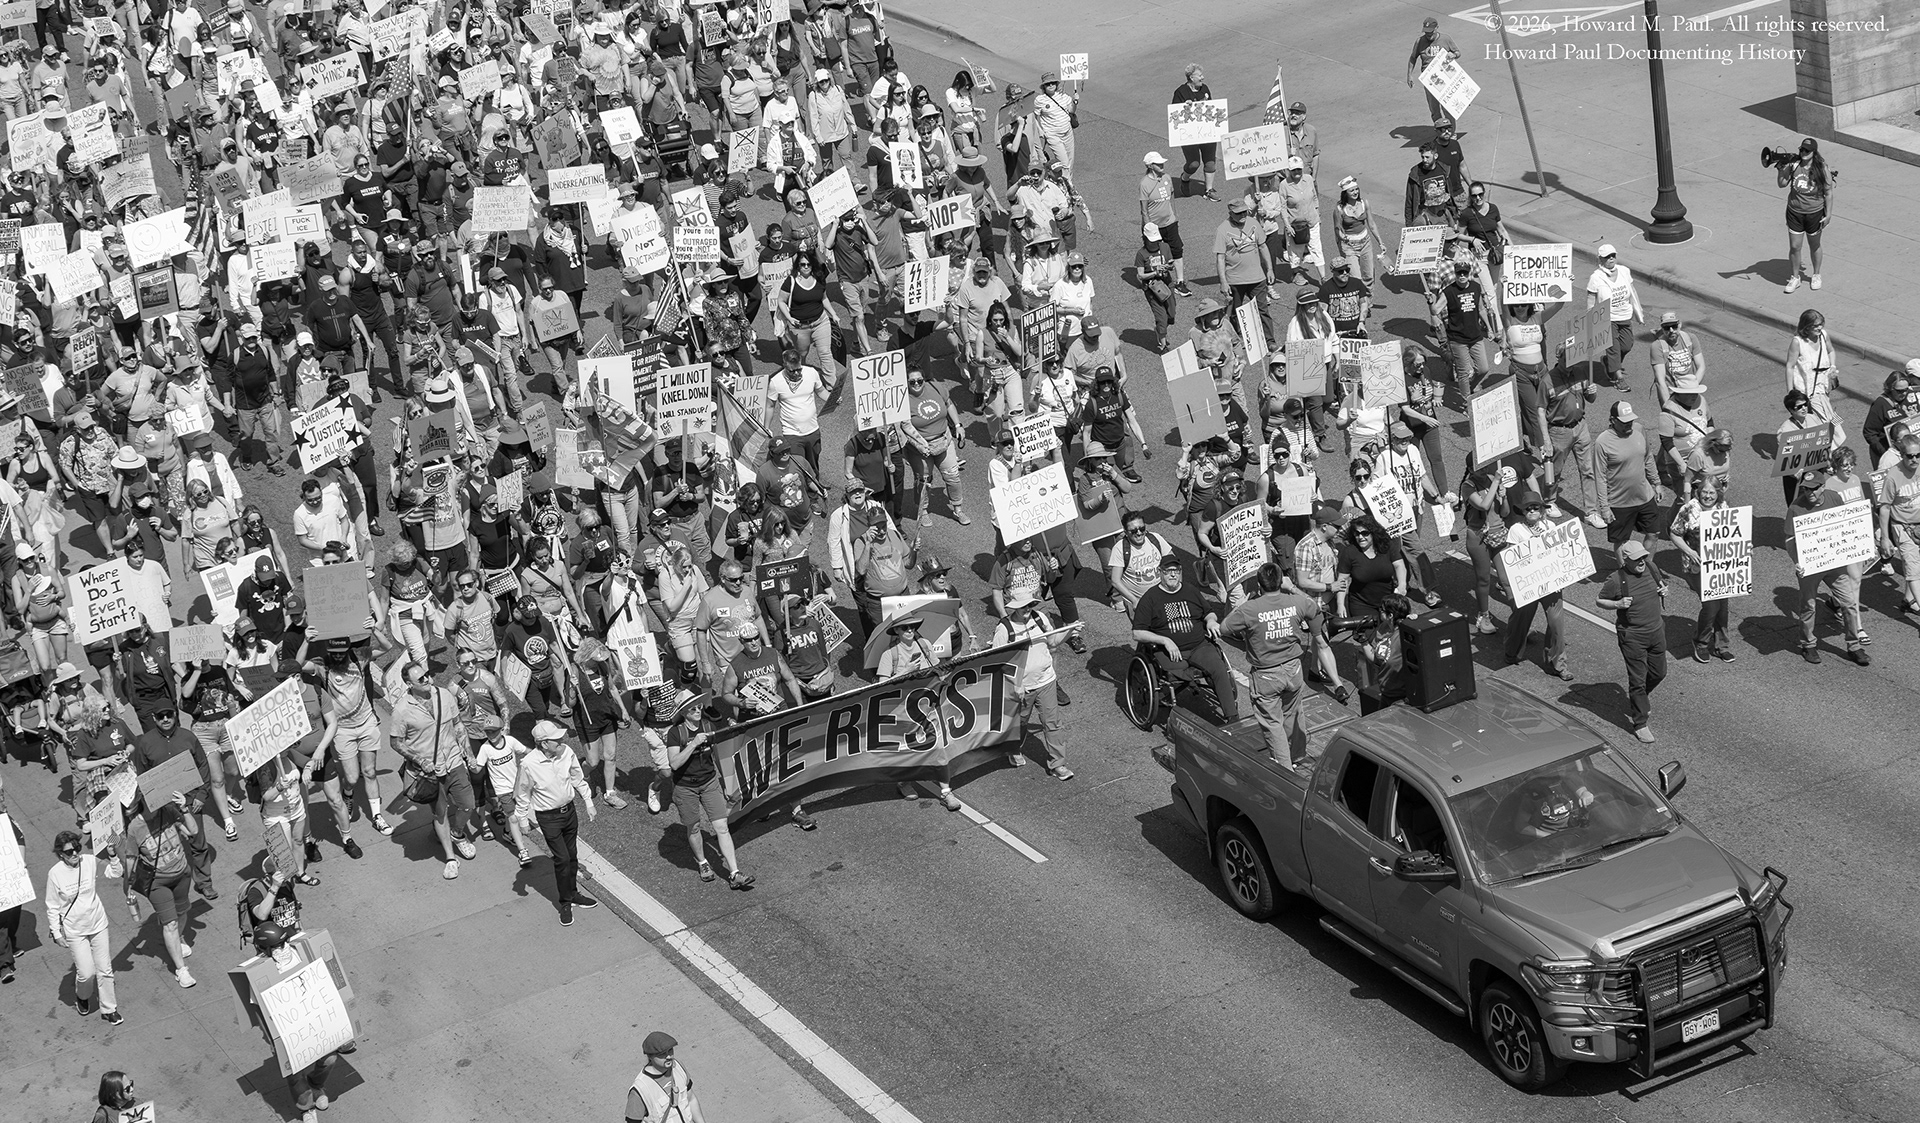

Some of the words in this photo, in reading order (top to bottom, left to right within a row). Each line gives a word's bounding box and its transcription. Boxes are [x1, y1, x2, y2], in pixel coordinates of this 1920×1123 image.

[1062, 54, 1075, 64] NO
[311, 63, 325, 75] NO
[322, 66, 345, 84] KINGS
[1061, 61, 1089, 76] KINGS
[1442, 76, 1467, 105] FASCISTS
[1239, 147, 1252, 156] for
[1258, 146, 1269, 155] my
[574, 169, 589, 177] ARE
[1229, 156, 1282, 173] Grandchildren
[216, 172, 230, 182] NO
[549, 174, 604, 191] UNDERREACTING
[572, 188, 590, 198] FEAR
[685, 212, 708, 228] NO
[621, 219, 657, 242] DIVERSITY
[634, 238, 655, 252] NOT
[682, 238, 718, 246] OUTRAGED
[1513, 255, 1569, 271] PEDOPHILE
[1513, 270, 1534, 280] PRIDE
[1535, 270, 1551, 278] FLAG
[1507, 282, 1529, 298] RED
[1529, 281, 1549, 297] HAT
[1023, 313, 1034, 327] NO
[1035, 305, 1054, 323] KING
[462, 324, 486, 333] resist.
[543, 329, 551, 337] NO
[554, 324, 569, 334] KINGS
[1030, 325, 1039, 337] NO
[1040, 318, 1055, 332] WAR
[73, 332, 94, 352] REICH
[1043, 330, 1055, 346] NO
[1043, 343, 1055, 356] ICE
[855, 352, 904, 381] STOP
[660, 375, 667, 389] I
[669, 371, 685, 388] WILL
[685, 368, 708, 386] NOT
[736, 376, 764, 392] LOVE
[870, 377, 892, 388] the
[661, 391, 687, 406] KNEEL
[687, 386, 709, 401] DOWN
[857, 385, 909, 416] ATROCITY
[663, 410, 675, 418] WILL
[1105, 411, 1116, 420] NO
[1476, 408, 1513, 433] CABINETS
[308, 417, 346, 450] JUSTICE
[660, 420, 671, 431] ICE
[662, 427, 673, 436] OUT
[1013, 419, 1051, 437] Democracy
[1018, 432, 1037, 446] Needs
[1036, 428, 1053, 440] Your
[1019, 438, 1053, 455] Courage
[309, 452, 322, 465] for
[1780, 453, 1801, 472] NO
[1002, 468, 1057, 497] MORONS
[1008, 495, 1031, 511] ARE
[1371, 495, 1380, 503] NO
[1380, 487, 1397, 499] KINGS
[1386, 495, 1397, 503] ICE
[1011, 493, 1072, 526] GOVERNING
[1379, 507, 1387, 515] NO
[1387, 500, 1403, 511] FEAR
[1016, 510, 1065, 537] AMERICA
[1221, 508, 1256, 532] WOMEN
[1711, 508, 1740, 528] SHE
[1225, 523, 1249, 542] BELONG
[1251, 520, 1263, 530] IN
[1237, 529, 1261, 545] PLACES
[1704, 527, 1730, 542] HAD
[1731, 526, 1742, 538] A
[1801, 530, 1819, 541] TRUMP
[1848, 518, 1864, 528] PATEL
[1504, 540, 1532, 566] ONLY
[1541, 521, 1581, 550] KING
[1802, 546, 1819, 556] NOEM
[1854, 533, 1871, 543] MUSK
[1816, 534, 1833, 544] VANCE
[1704, 541, 1751, 562] WHISTLE
[1846, 548, 1871, 561] MILLER
[1229, 565, 1248, 581] MADE
[1514, 561, 1560, 591] BIRTHDAY
[1561, 554, 1588, 573] PARTY
[1703, 558, 1731, 574] They
[1732, 556, 1750, 569] Had
[79, 568, 119, 588] Where
[1522, 590, 1536, 601] WITH
[1554, 572, 1574, 587] TAXES
[1709, 568, 1749, 591] GUNS!
[87, 588, 108, 602] Do
[110, 579, 123, 594] I
[1703, 586, 1736, 598] PROSECUTE
[1737, 583, 1753, 594] ICE
[88, 597, 127, 618] Even
[1258, 606, 1297, 623] SOCIALISM
[89, 605, 137, 635] Start?
[1267, 621, 1275, 631] IS
[1276, 618, 1291, 629] THE
[618, 638, 627, 647] NO
[628, 636, 647, 646] WARS
[1265, 626, 1294, 640] FUTURE
[743, 663, 776, 680] AMERICAN
[626, 676, 641, 687] JUST
[641, 674, 662, 686] PEACE
[251, 684, 296, 722] BLOOM
[249, 700, 297, 740] BETTER
[244, 713, 299, 758] WITHOUT
[732, 716, 810, 811] WE
[825, 663, 1018, 763] RESIST
[1411, 935, 1440, 957] TUNDRA
[269, 985, 291, 1005] NO
[279, 1006, 299, 1025] NO
[299, 987, 334, 1018] ICE
[288, 1006, 337, 1050] DEATH
[313, 1027, 327, 1043] TO
[296, 1026, 353, 1069] PEDOPHILES
